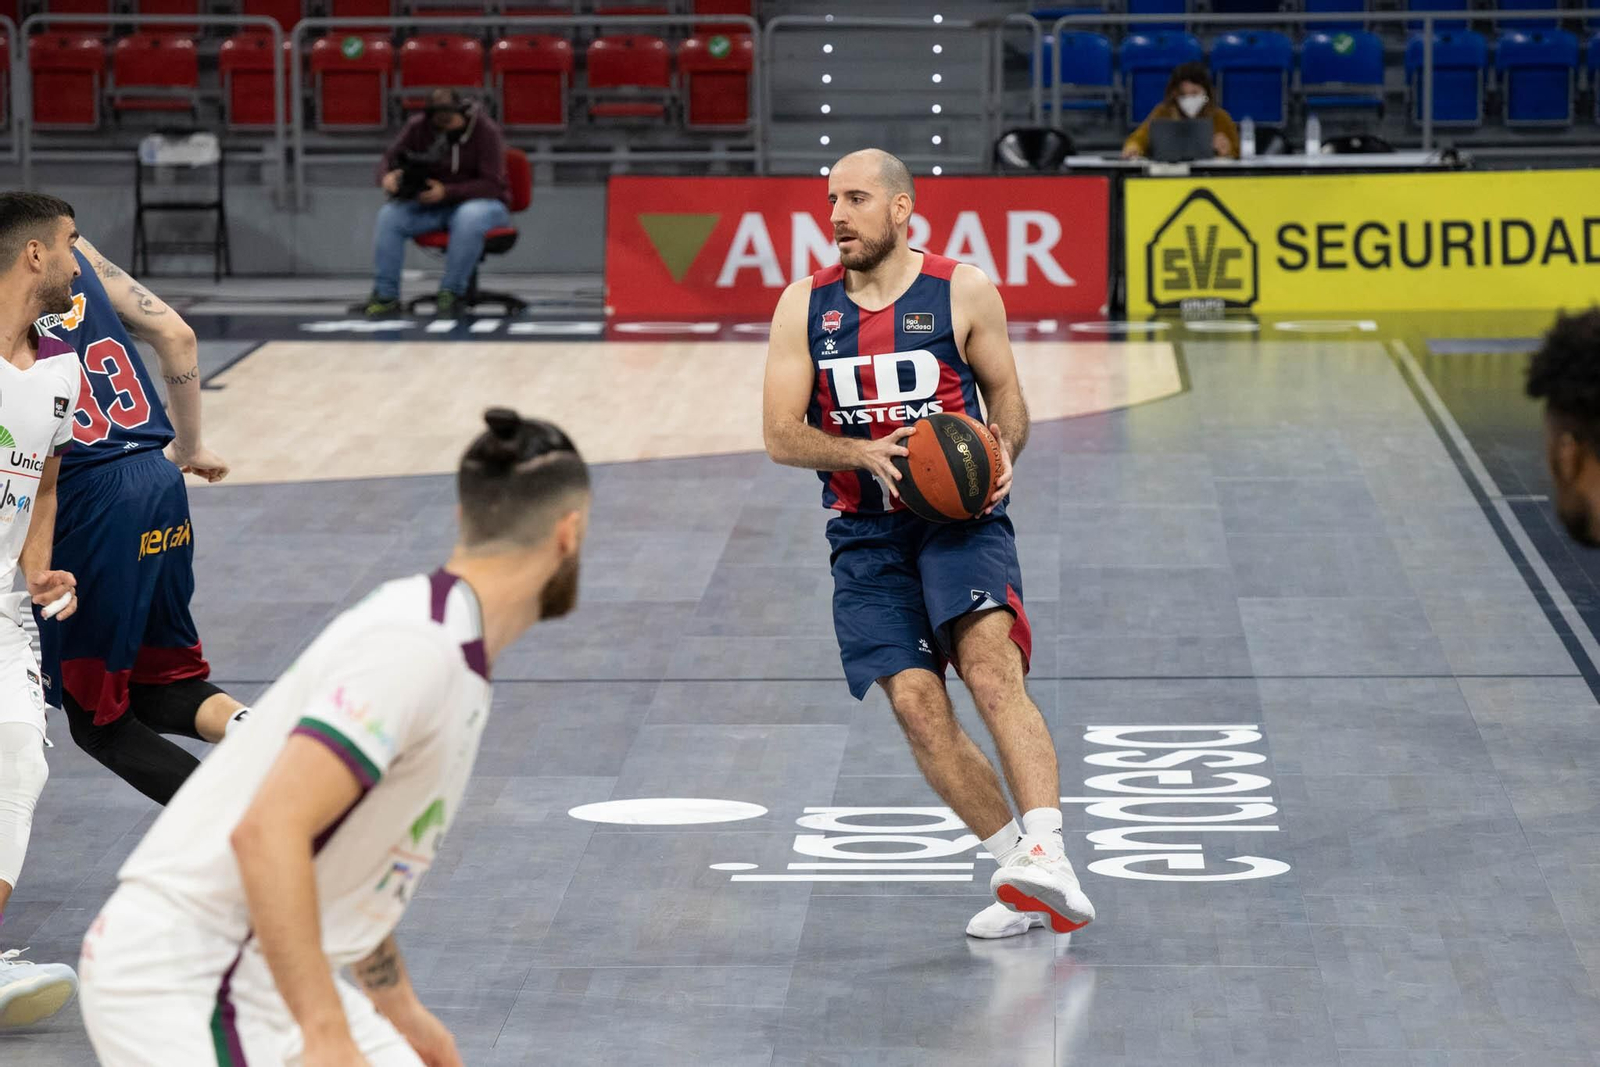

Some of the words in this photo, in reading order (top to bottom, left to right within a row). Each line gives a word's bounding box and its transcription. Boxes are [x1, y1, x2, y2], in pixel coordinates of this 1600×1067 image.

[1163, 225, 1243, 290] SVC
[818, 349, 941, 408] TD
[829, 400, 943, 425] SYSTEMS
[0, 479, 31, 513] laga
